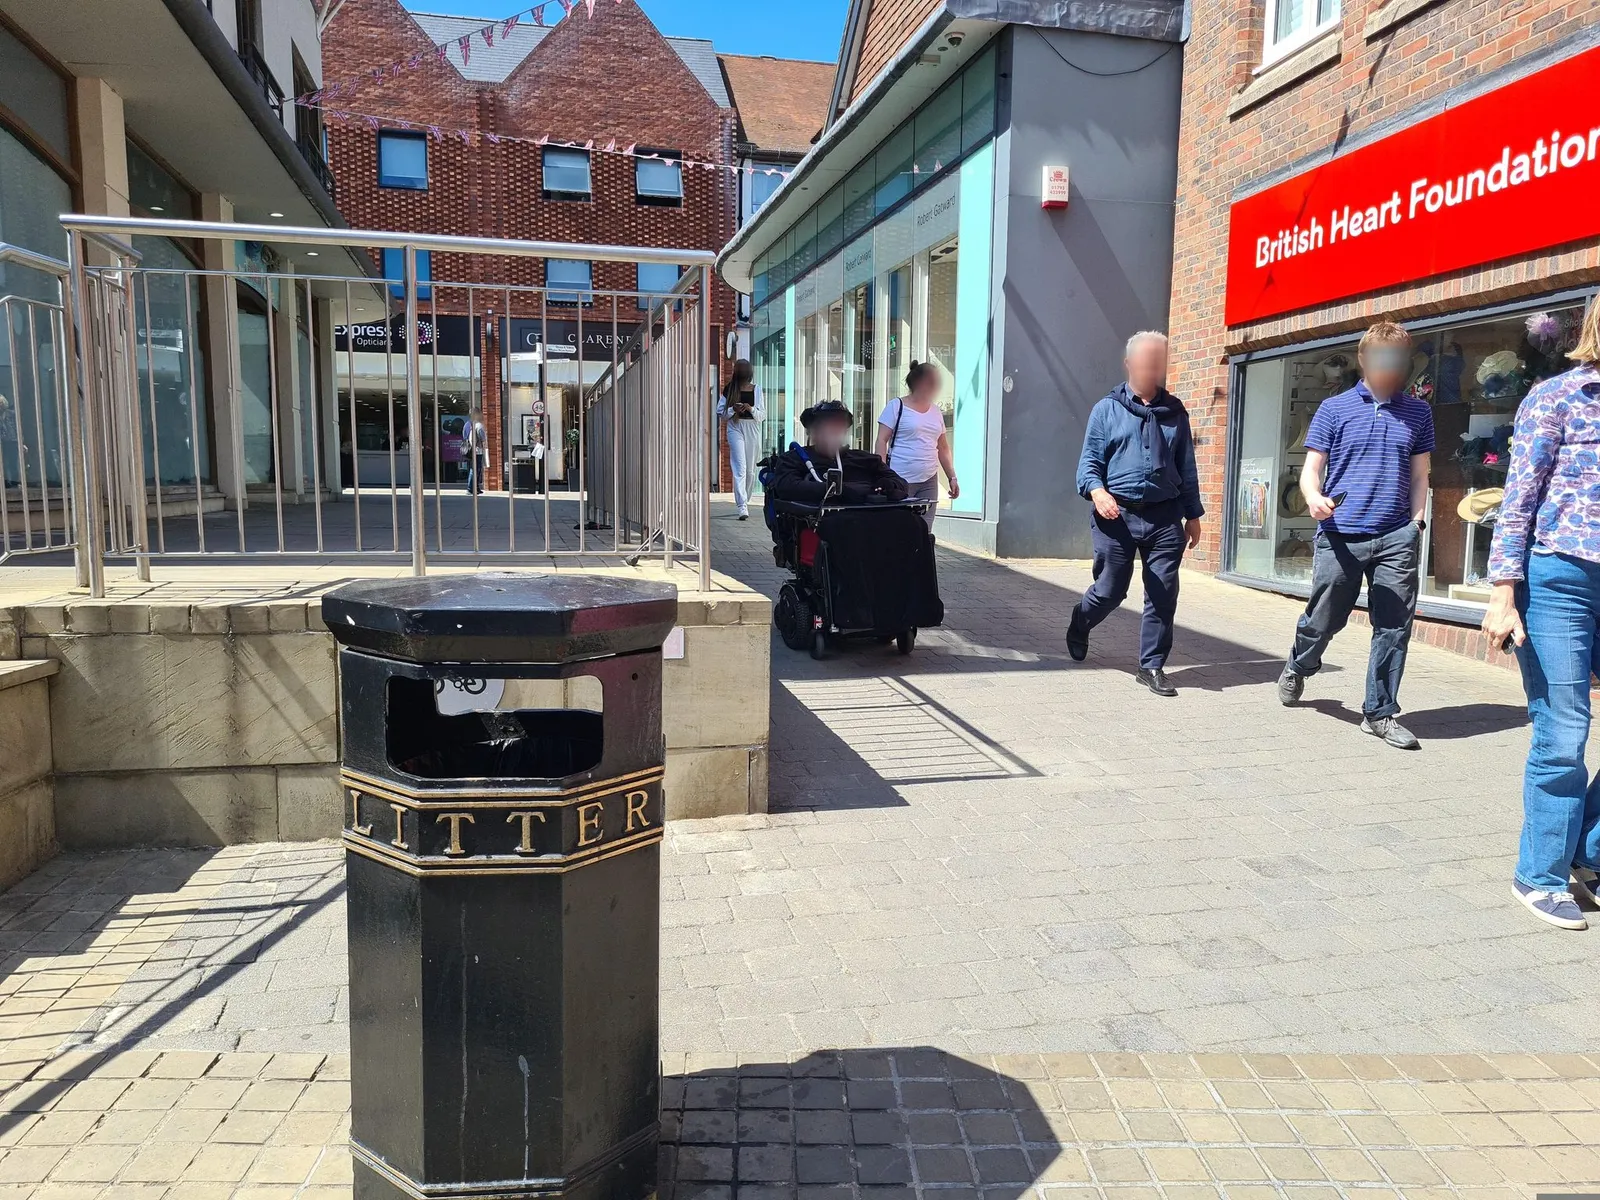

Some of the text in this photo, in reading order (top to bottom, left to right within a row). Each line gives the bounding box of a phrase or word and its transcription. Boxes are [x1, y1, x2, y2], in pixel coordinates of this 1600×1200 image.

[917, 209, 933, 226] Robert
[1255, 216, 1323, 269] British
[1329, 192, 1402, 245] Heart
[350, 789, 650, 856] LITTER
